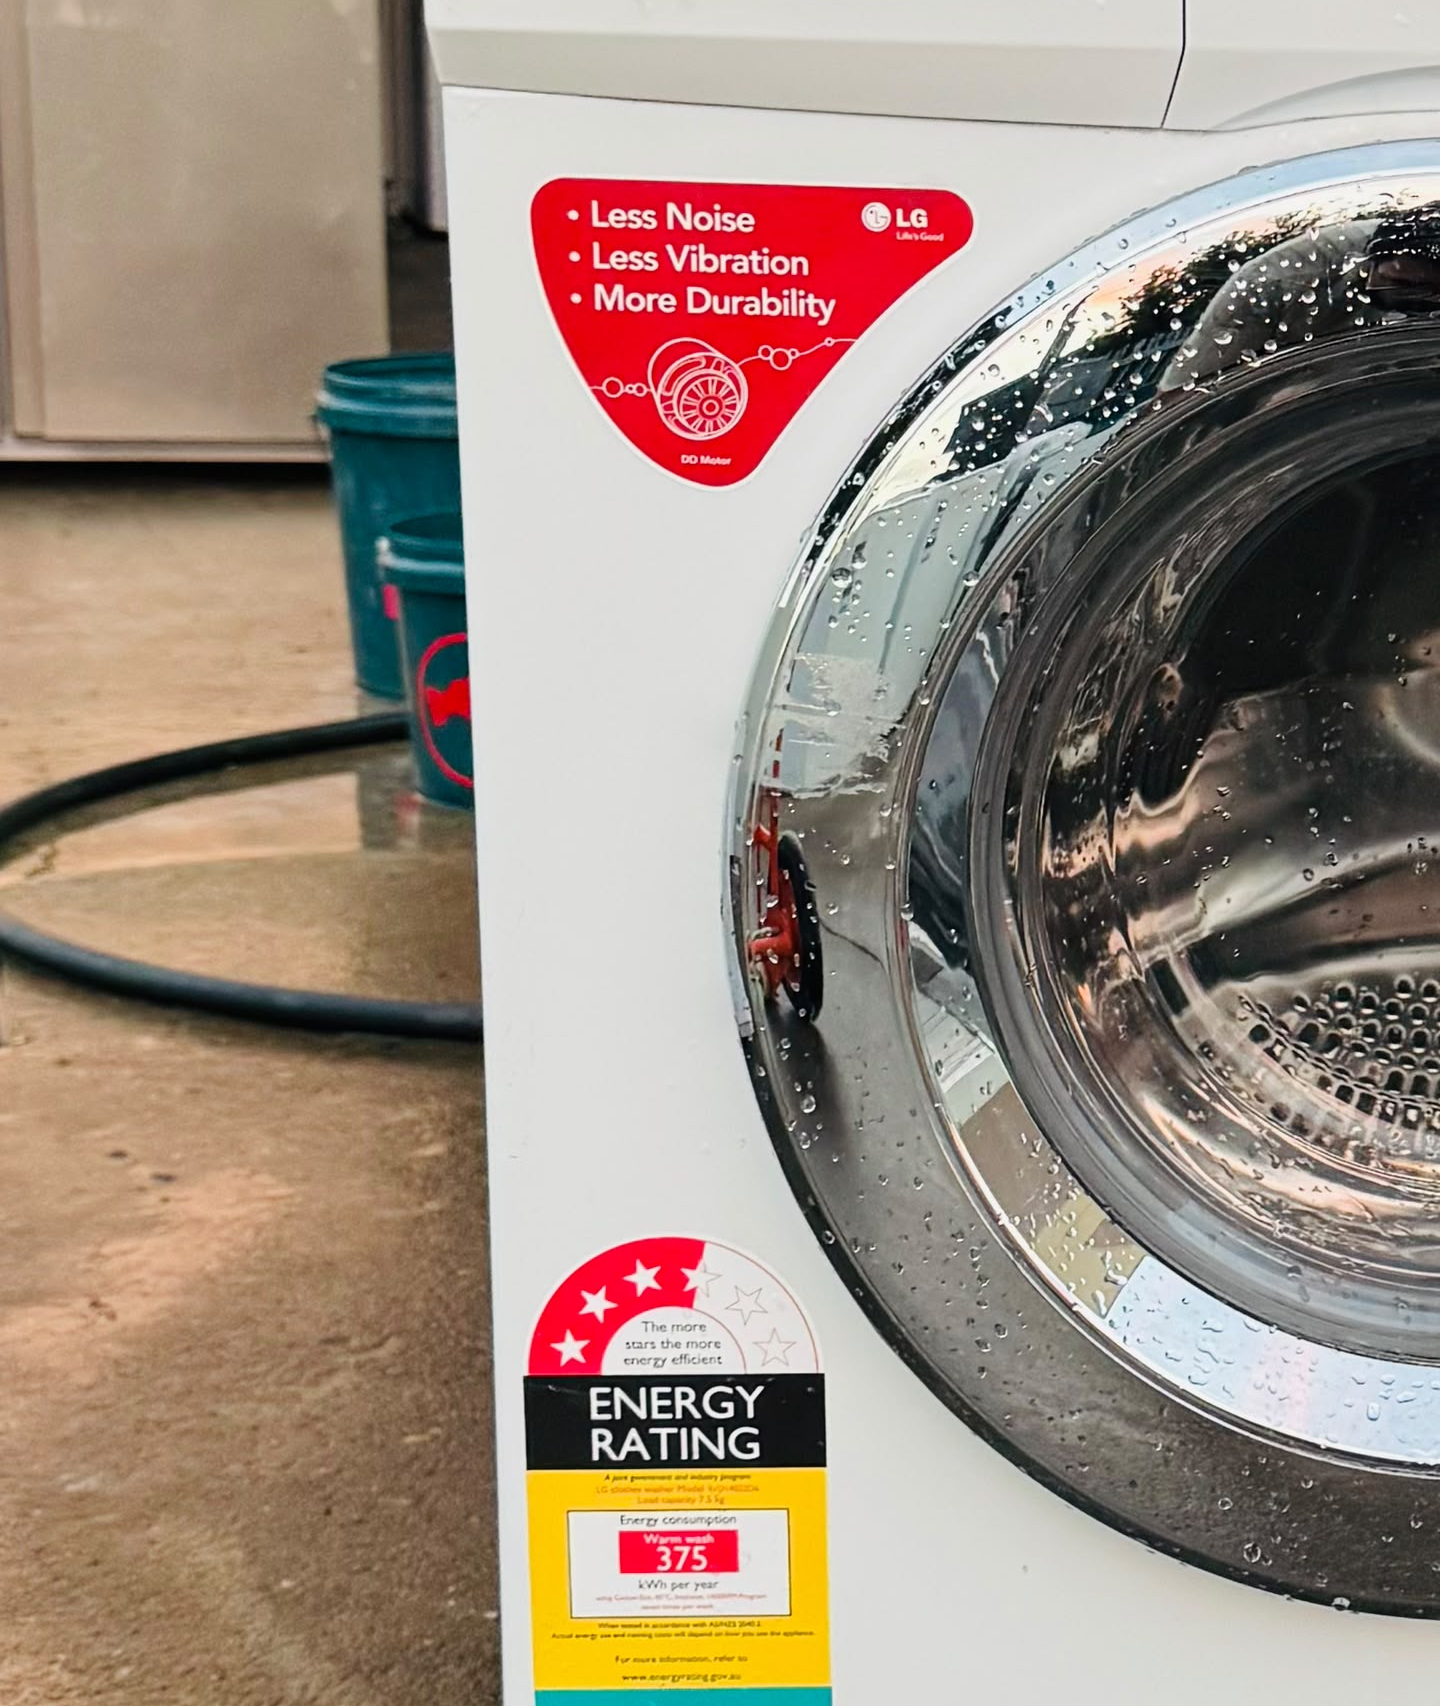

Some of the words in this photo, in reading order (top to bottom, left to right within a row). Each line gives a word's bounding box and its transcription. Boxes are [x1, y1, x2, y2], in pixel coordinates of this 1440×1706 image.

[590, 200, 658, 230] Less
[667, 203, 756, 233] Noise
[896, 208, 928, 228] LG
[592, 242, 659, 272] Less
[665, 243, 809, 276] Vibration
[594, 284, 677, 314] More
[686, 286, 836, 326] Durability
[680, 454, 698, 465] DD
[700, 454, 732, 467] Motor
[641, 1321, 667, 1333] The
[671, 1323, 707, 1333] more
[625, 1340, 657, 1350] stars
[660, 1338, 682, 1349] the
[686, 1340, 721, 1349] more
[624, 1356, 667, 1368] energy
[671, 1353, 723, 1365] efficient
[589, 1385, 765, 1421] ENERGY
[591, 1426, 761, 1462] RATING
[620, 1515, 658, 1527] Energy
[662, 1515, 737, 1526] consumption
[643, 1533, 682, 1544] Warm
[685, 1533, 715, 1544] wash
[656, 1545, 708, 1572] 375
[638, 1579, 667, 1590] kWh
[671, 1581, 689, 1591] per
[695, 1581, 719, 1591] year
